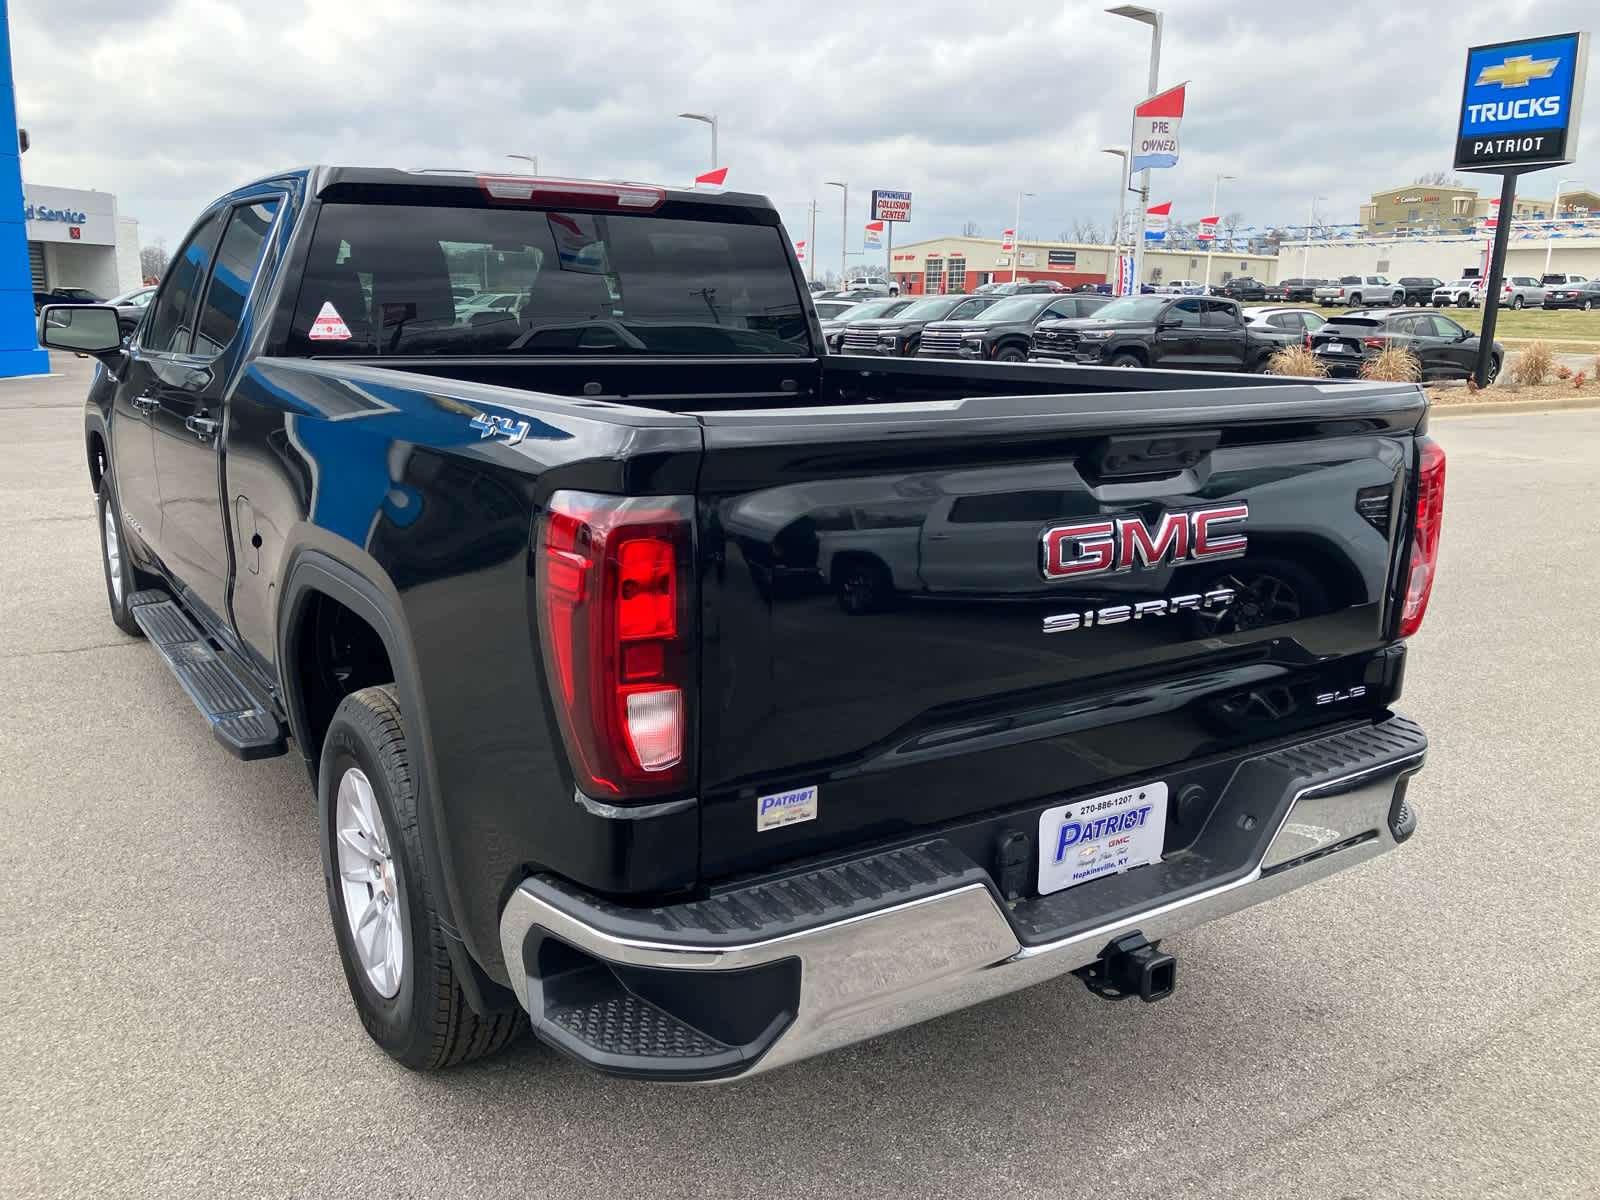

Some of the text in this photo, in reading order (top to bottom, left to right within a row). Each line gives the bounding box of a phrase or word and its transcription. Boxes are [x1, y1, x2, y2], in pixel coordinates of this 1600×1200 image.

[1468, 96, 1560, 123] TRUCKS
[1151, 121, 1169, 134] PRE
[1142, 140, 1176, 152] OWNED
[1474, 137, 1544, 155] PATRIOT
[877, 199, 910, 210] COLLISION
[37, 206, 87, 224] Service
[881, 210, 906, 219] CENTER
[1042, 504, 1249, 579] GMC
[1042, 588, 1235, 633] SIERRA
[1316, 686, 1366, 705] SLE
[1080, 795, 1133, 815] 270-886-1207
[1108, 836, 1130, 848] GMC
[1118, 857, 1129, 865] KY
